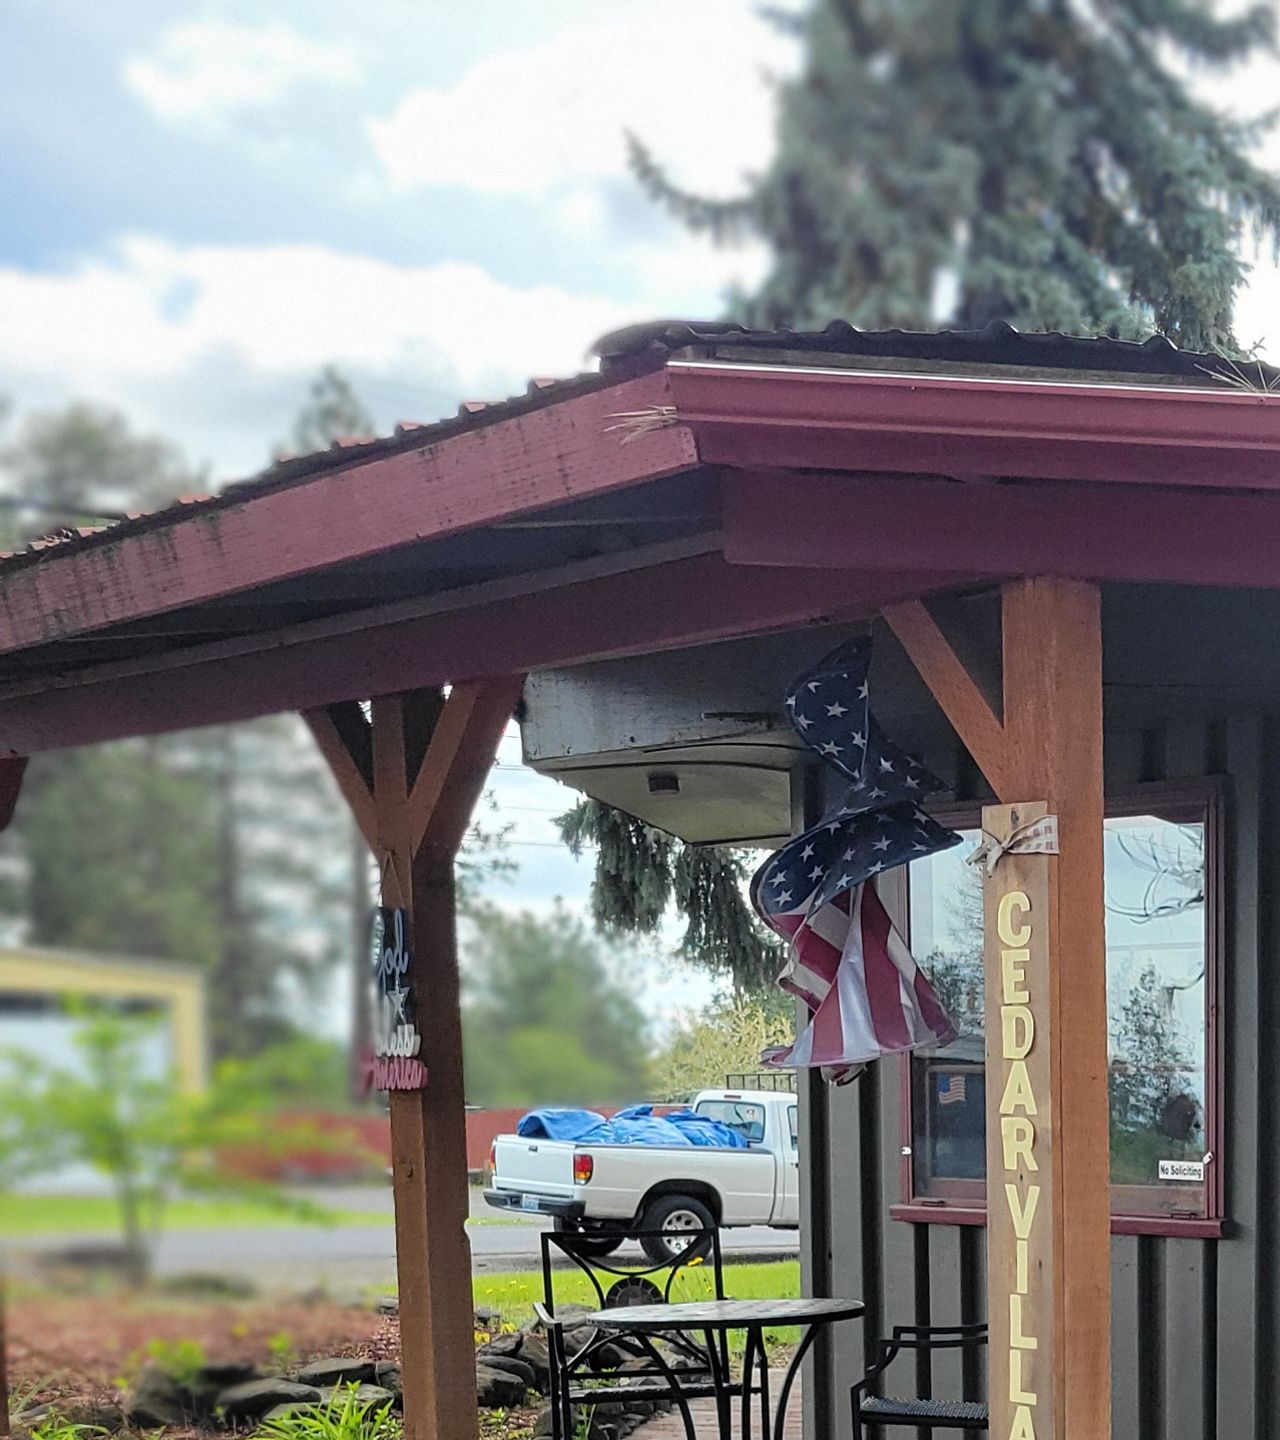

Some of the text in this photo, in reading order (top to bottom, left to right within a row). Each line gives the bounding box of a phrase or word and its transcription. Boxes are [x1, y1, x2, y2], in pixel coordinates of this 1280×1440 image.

[996, 891, 1039, 1172] CEDAR
[1160, 1165, 1203, 1179] No Soliciting
